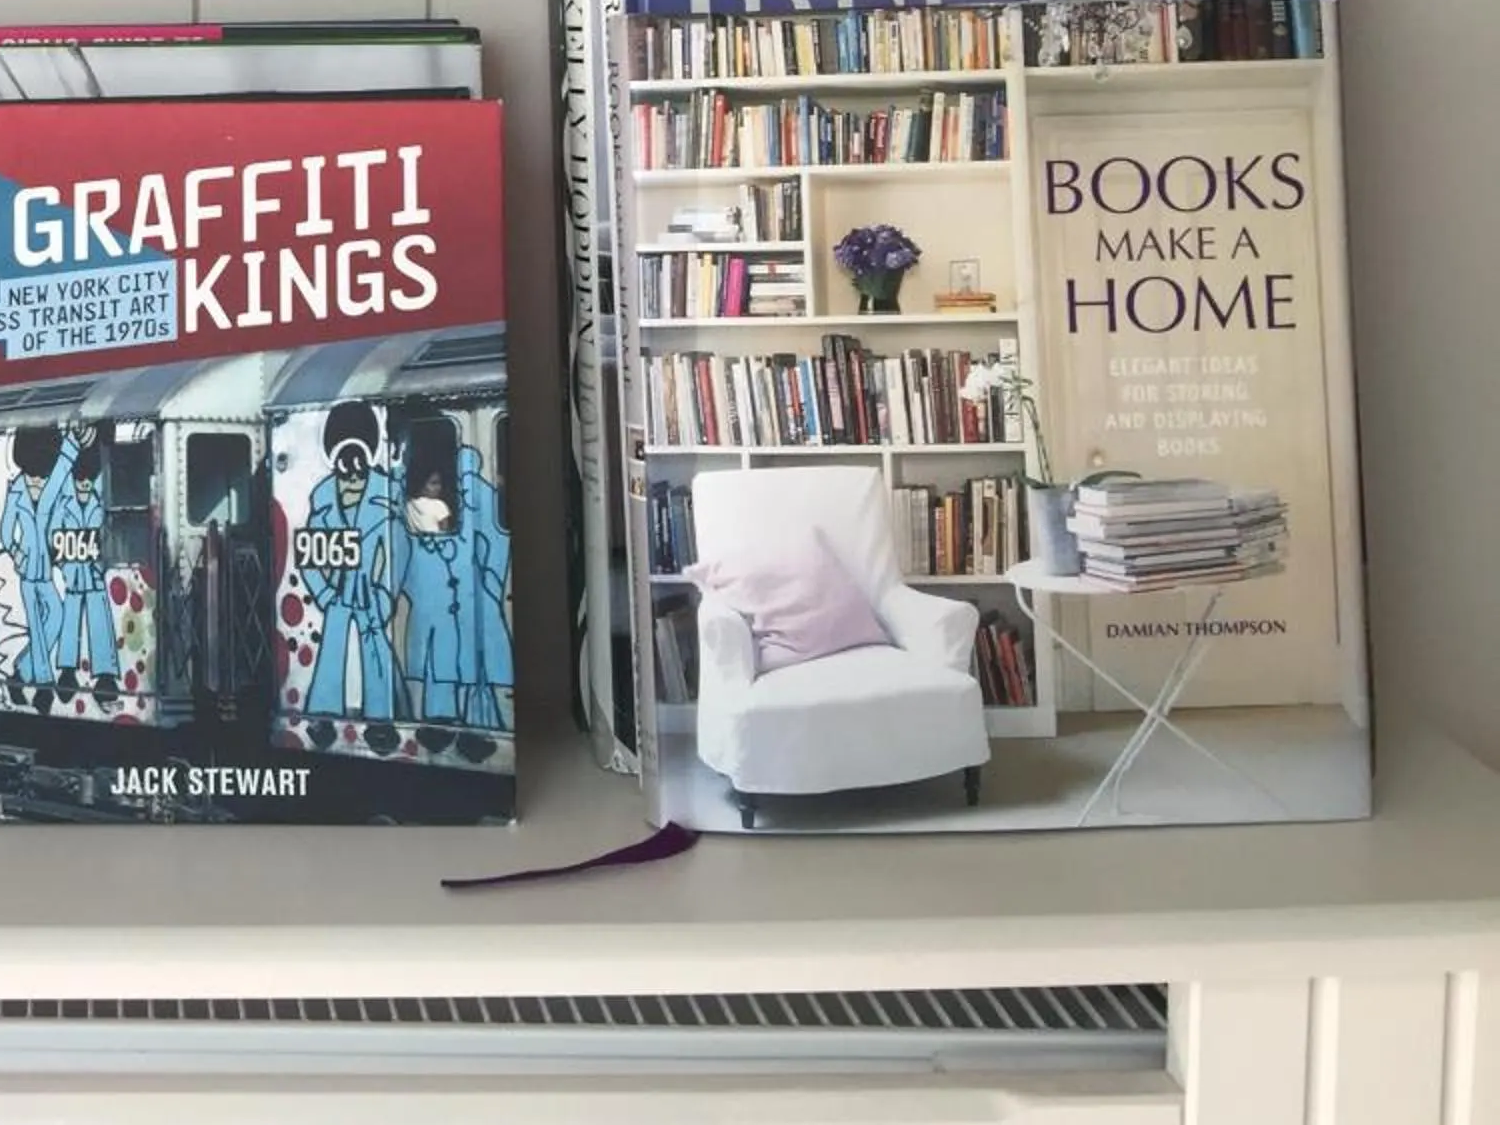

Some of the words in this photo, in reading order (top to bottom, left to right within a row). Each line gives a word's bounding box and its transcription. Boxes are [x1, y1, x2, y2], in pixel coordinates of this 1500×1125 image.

[1045, 152, 1305, 215] BOOKS
[12, 144, 432, 268] GRAFFITI
[1095, 226, 1218, 262] MAKE
[1231, 226, 1260, 260] A
[7, 282, 50, 308] NEW
[57, 277, 111, 301] YORK
[117, 270, 170, 294] CITY
[184, 233, 438, 334] KINGS
[29, 298, 121, 327] TRANSIT
[129, 292, 170, 316] ART
[1066, 274, 1297, 334] HOME
[22, 329, 50, 353] OF
[56, 324, 97, 349] THE
[105, 317, 171, 343] 1970s
[1104, 411, 1146, 431] AND
[52, 530, 100, 562] 9064
[295, 530, 361, 566] 9065
[1106, 622, 1180, 639] DAMIAN
[1185, 618, 1288, 637] THOMPSON
[110, 767, 179, 796] JACK
[188, 767, 311, 797] STEWART
